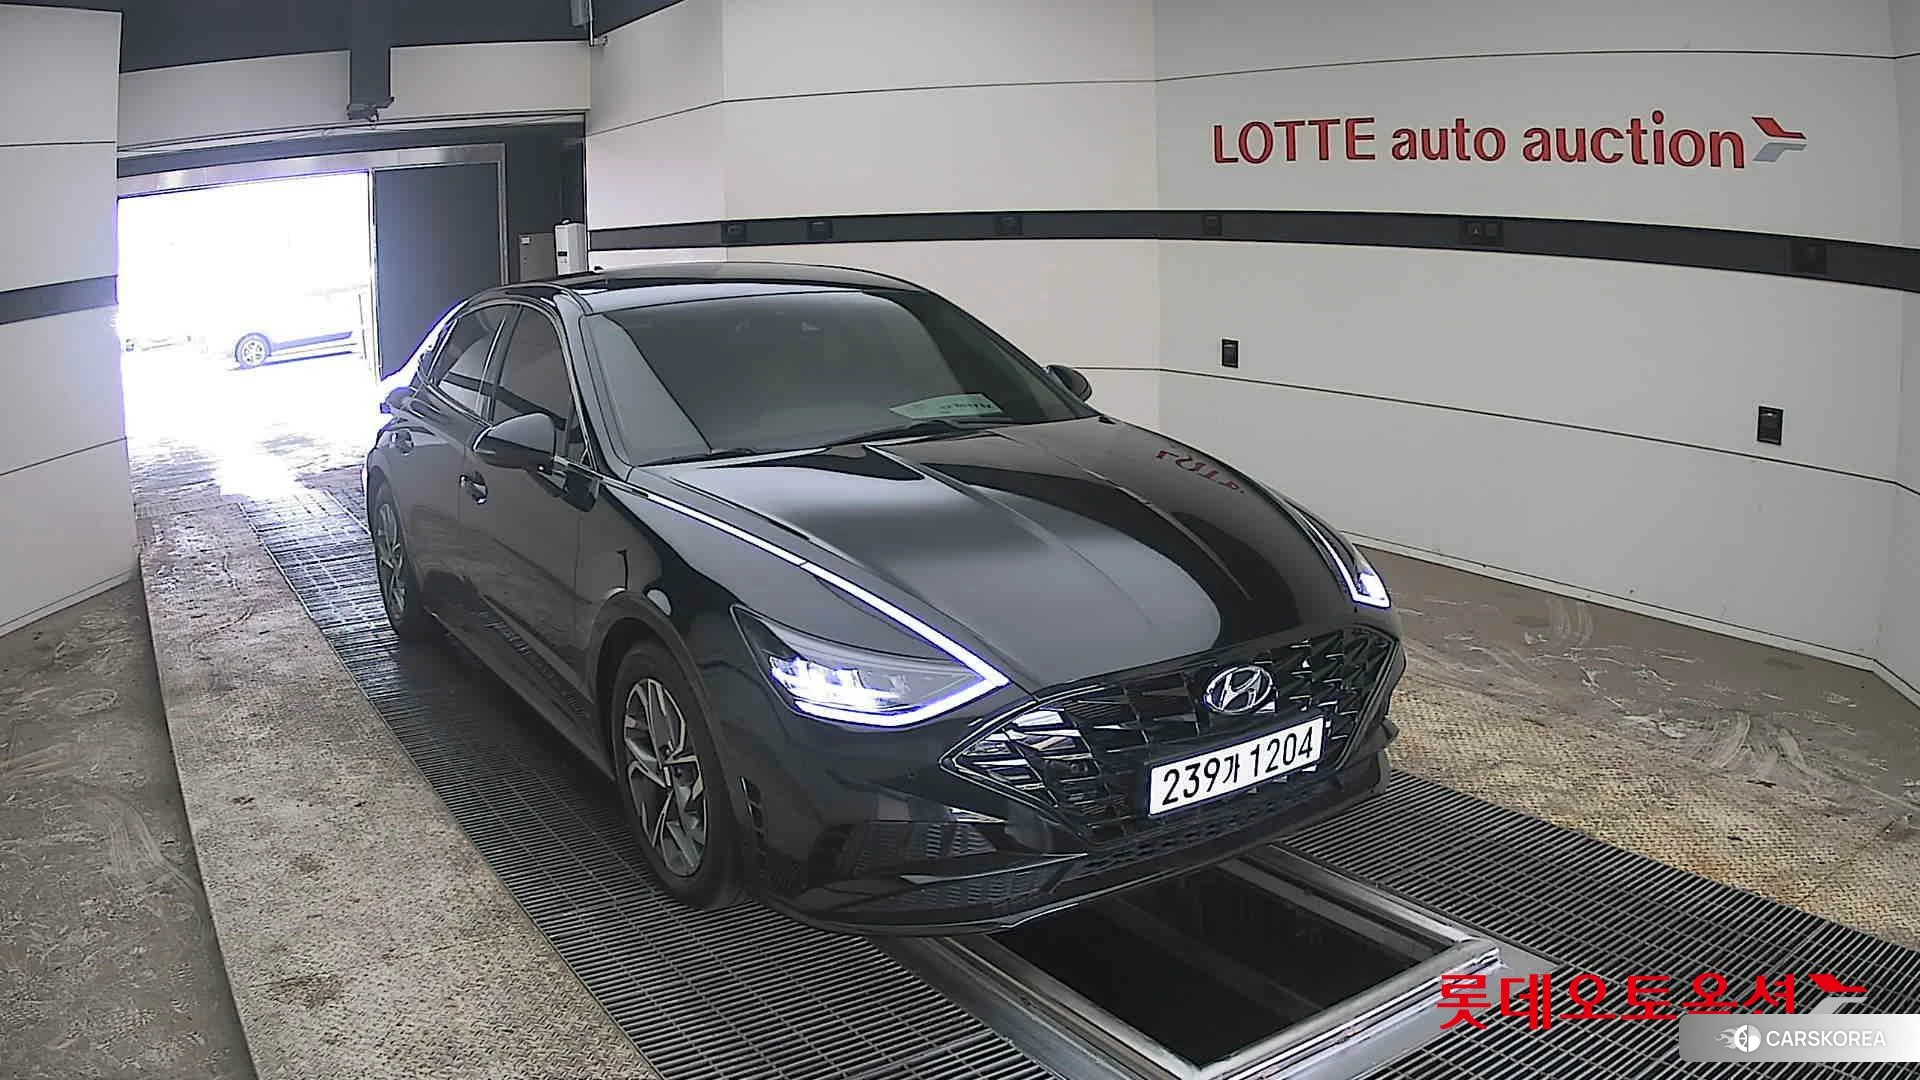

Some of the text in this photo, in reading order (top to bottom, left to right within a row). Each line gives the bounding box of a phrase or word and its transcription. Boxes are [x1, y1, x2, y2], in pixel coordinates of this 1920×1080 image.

[1213, 110, 1746, 169] LOTTE auto auction
[1162, 726, 1314, 806] 239가 1204
